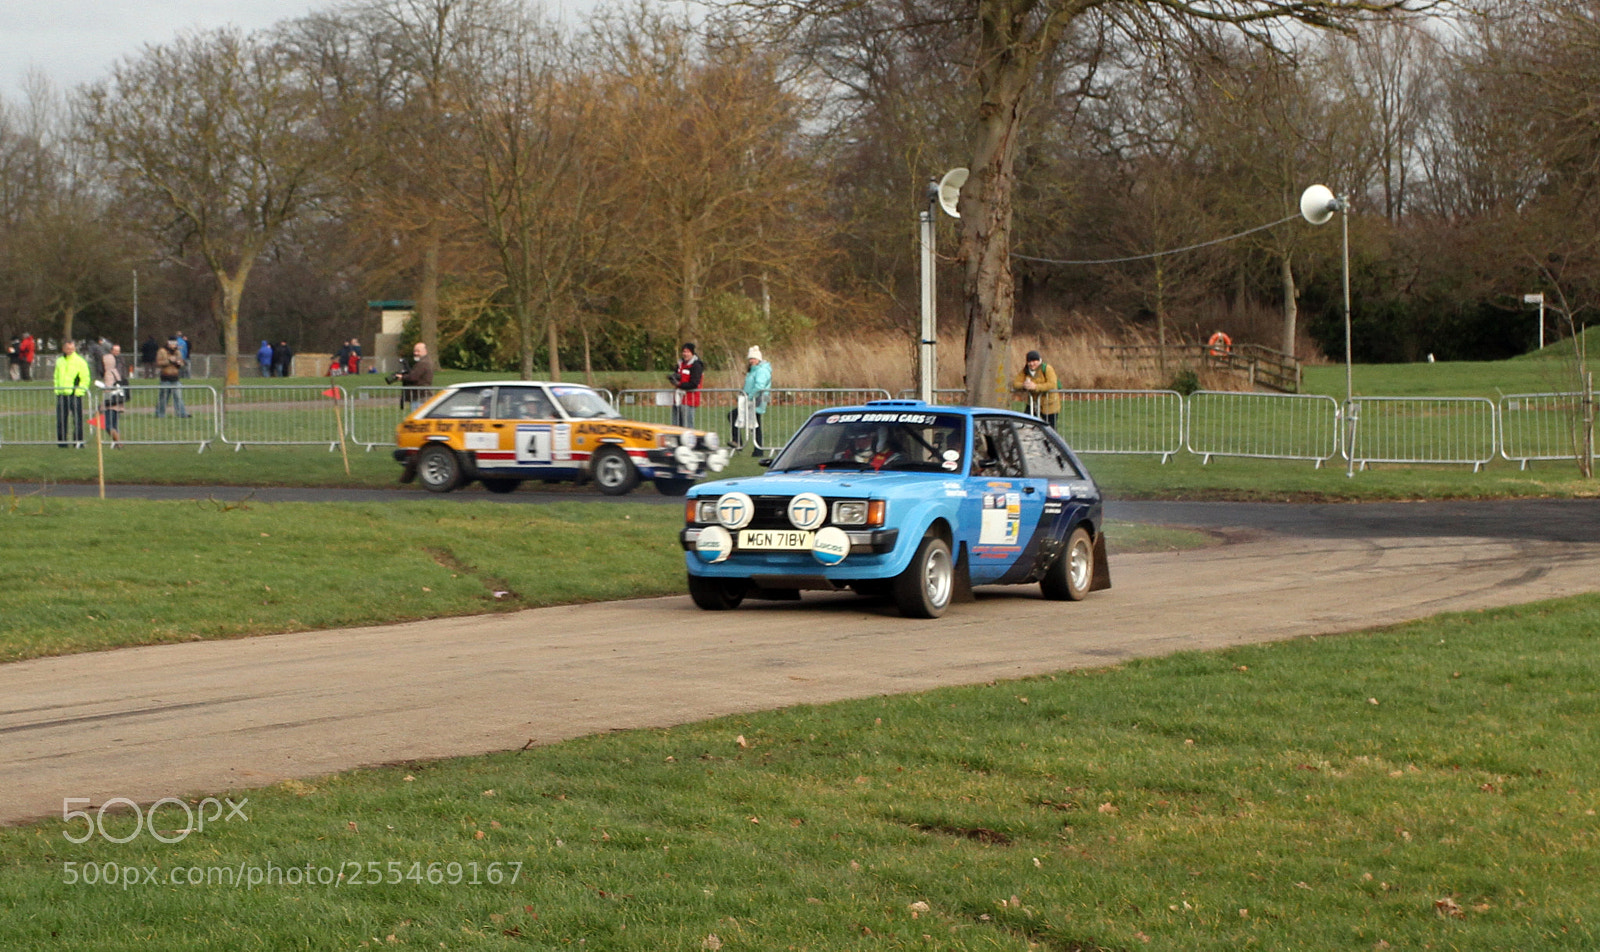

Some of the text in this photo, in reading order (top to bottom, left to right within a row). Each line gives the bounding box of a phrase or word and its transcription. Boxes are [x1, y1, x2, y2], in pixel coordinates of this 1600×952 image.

[861, 413, 899, 422] BROWN
[898, 414, 926, 424] CARS
[525, 434, 537, 458] 4
[746, 533, 807, 547] MGN 718V
